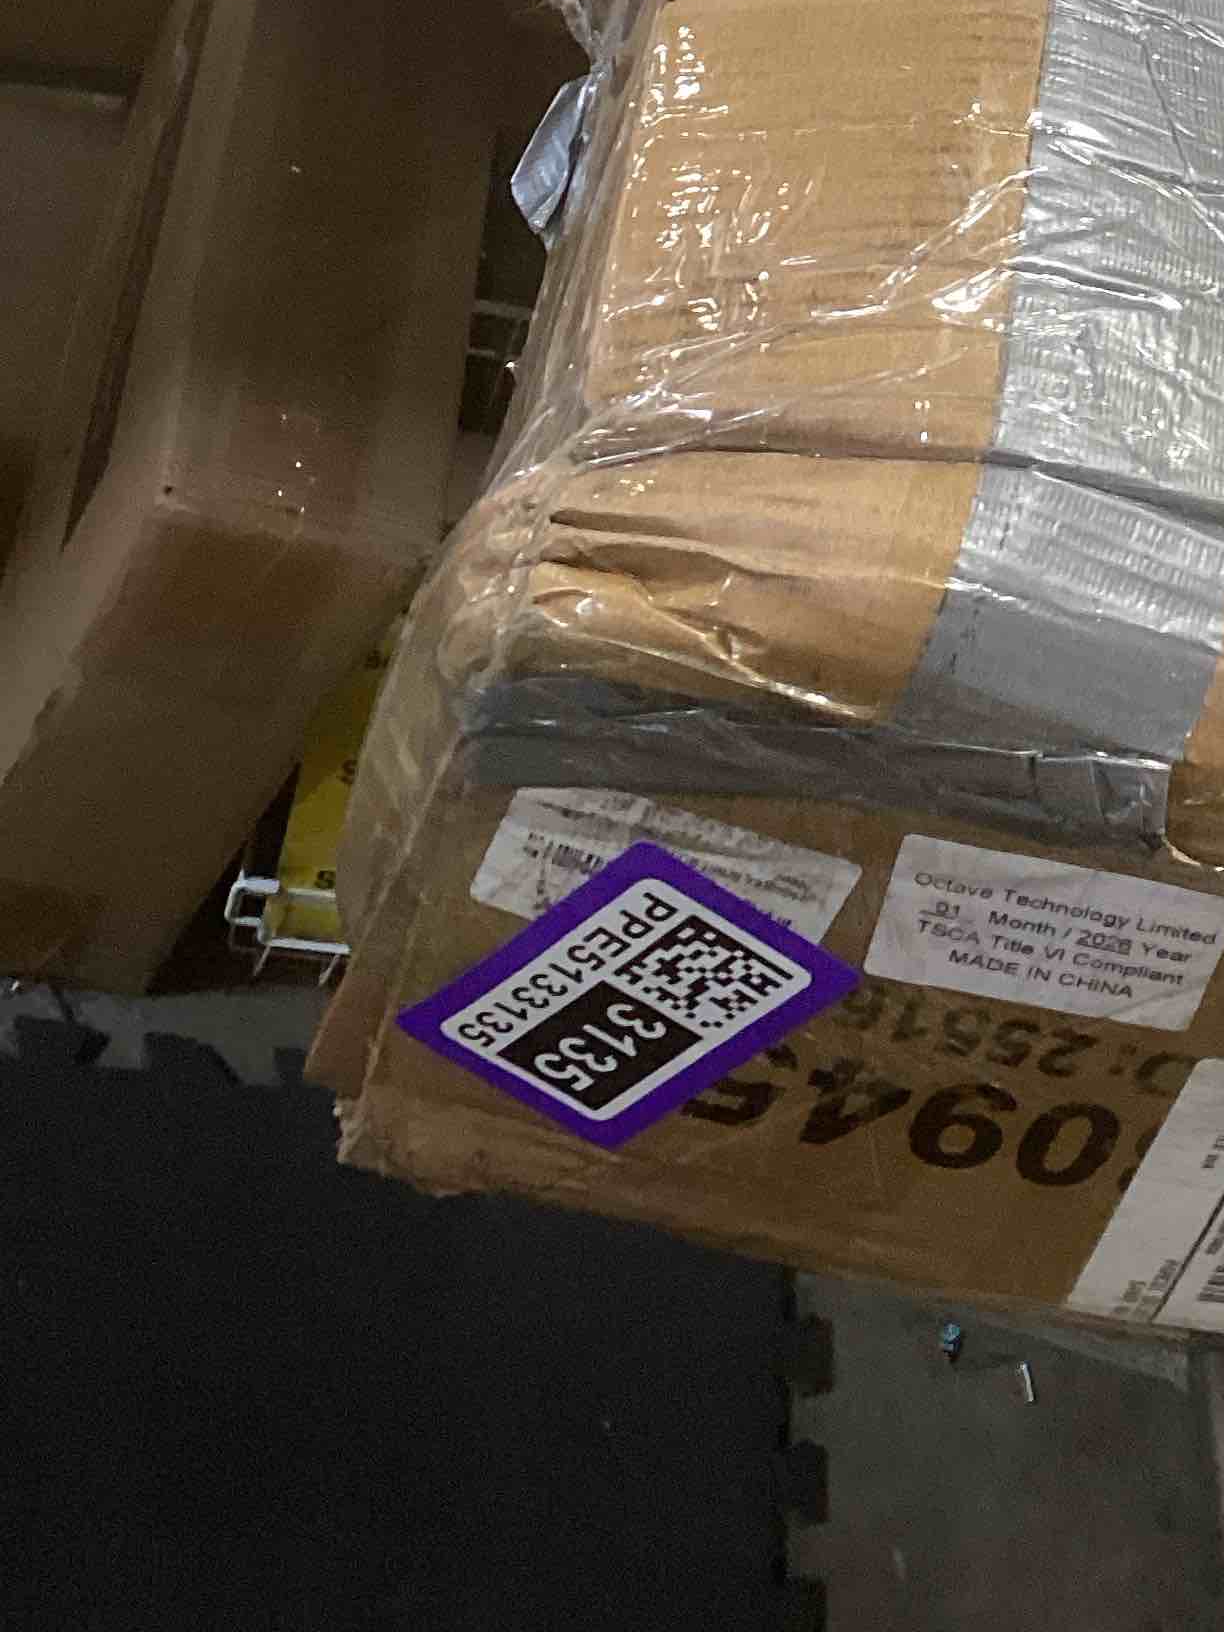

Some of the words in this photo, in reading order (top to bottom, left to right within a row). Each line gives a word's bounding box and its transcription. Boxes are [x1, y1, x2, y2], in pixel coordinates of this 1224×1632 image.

[913, 871, 993, 901] Octave
[1002, 887, 1132, 930] Technology
[1136, 918, 1217, 947] Limited
[987, 910, 1056, 938] Month
[1141, 941, 1192, 964] Year
[457, 891, 679, 1049] PPE5133135
[916, 920, 980, 946] TSCA
[990, 933, 1035, 956] Title
[1072, 951, 1184, 986] Compliant
[947, 949, 1020, 976] MADE
[1026, 967, 1051, 982] IN
[1057, 972, 1134, 999] CHINA
[533, 1002, 668, 1091] 3135
